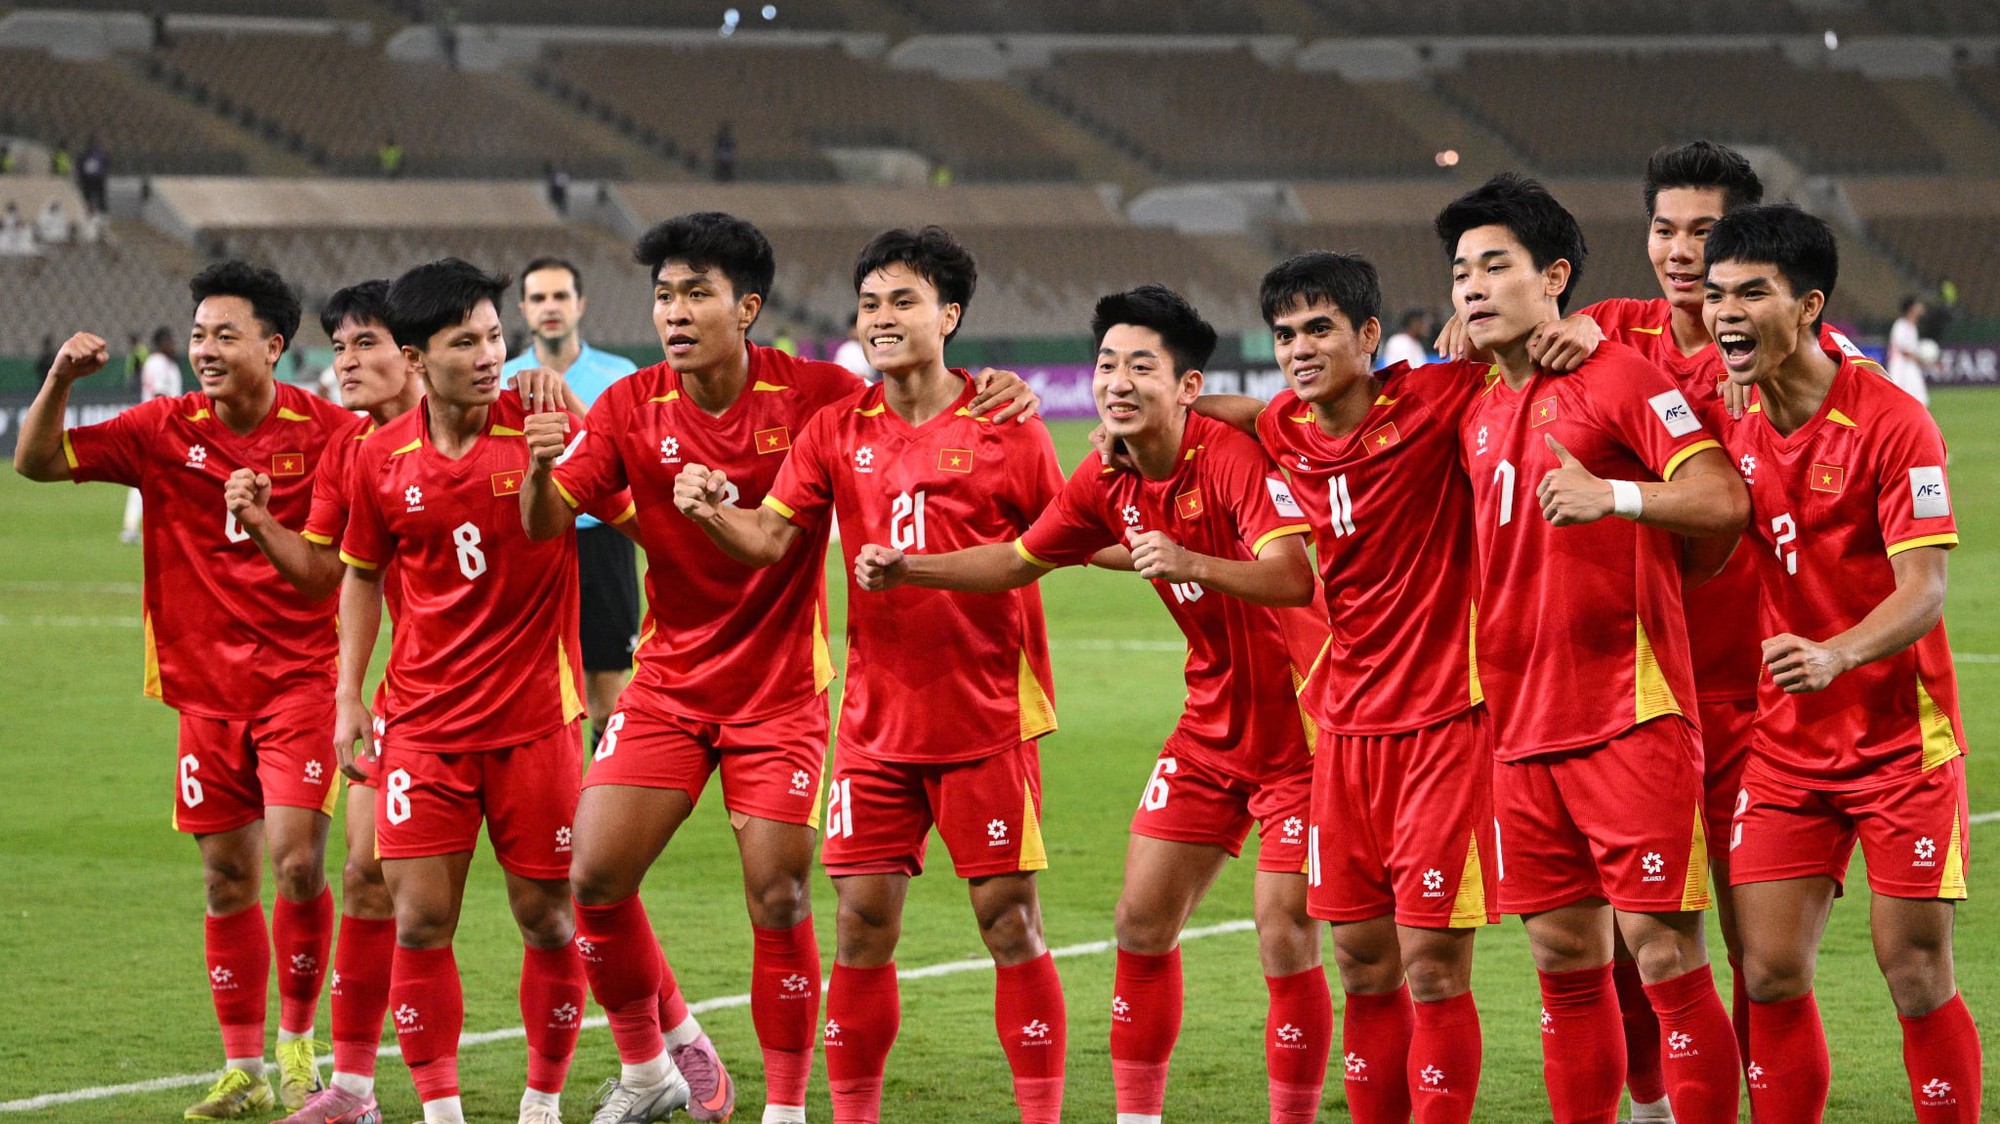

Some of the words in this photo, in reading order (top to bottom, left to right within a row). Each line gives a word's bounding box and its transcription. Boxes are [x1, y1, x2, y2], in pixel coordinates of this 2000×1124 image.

[1665, 405, 1687, 421] AFC
[1275, 493, 1292, 504] AFC
[1328, 473, 1356, 540] 11
[1917, 484, 1941, 497] AFC
[890, 490, 926, 551] 21
[1771, 512, 1797, 576] 2
[453, 521, 487, 581] 8
[594, 711, 625, 763] 3
[180, 753, 204, 809] 6
[386, 768, 412, 826] 8
[826, 777, 853, 840] 21
[1729, 787, 1749, 852] 2
